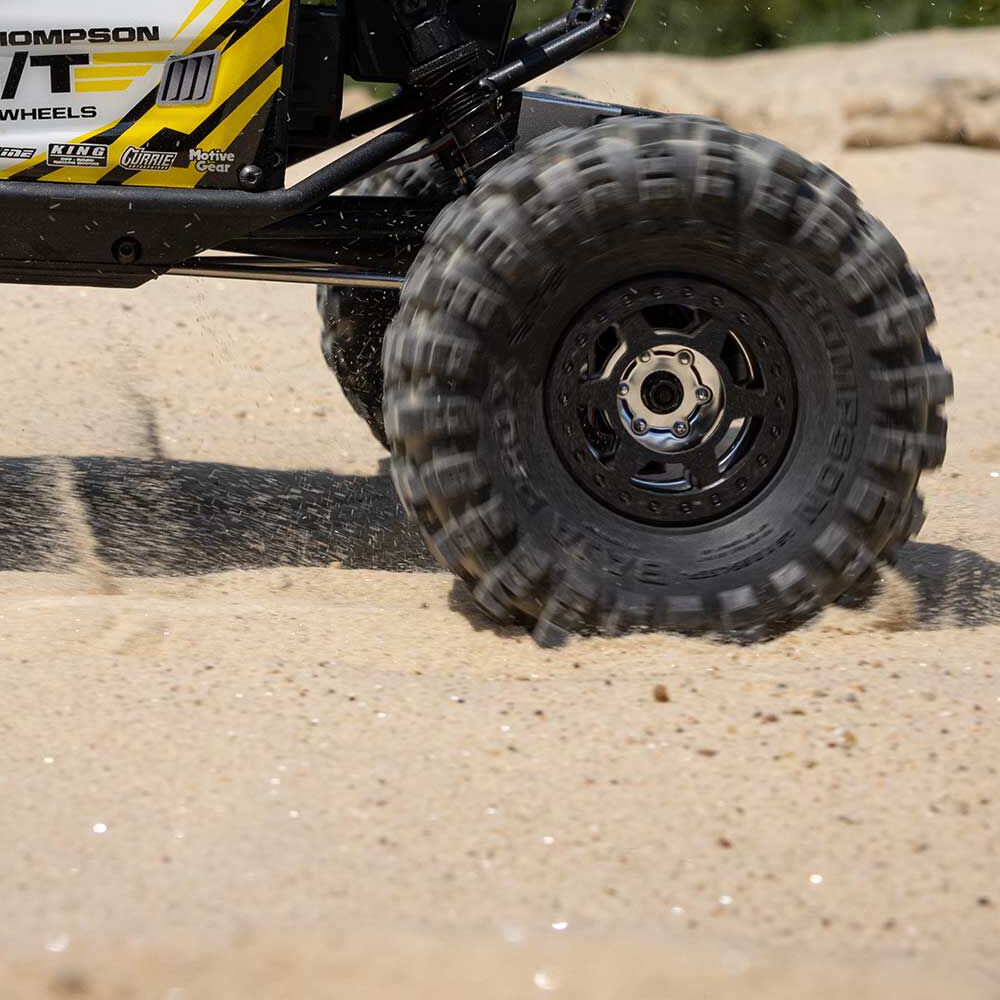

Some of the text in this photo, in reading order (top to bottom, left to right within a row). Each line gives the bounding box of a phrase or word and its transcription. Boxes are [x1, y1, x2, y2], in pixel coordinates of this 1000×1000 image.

[50, 144, 106, 156] KING
[121, 146, 175, 167] CURRIE
[188, 148, 235, 162] Motive
[195, 161, 231, 173] Gear
